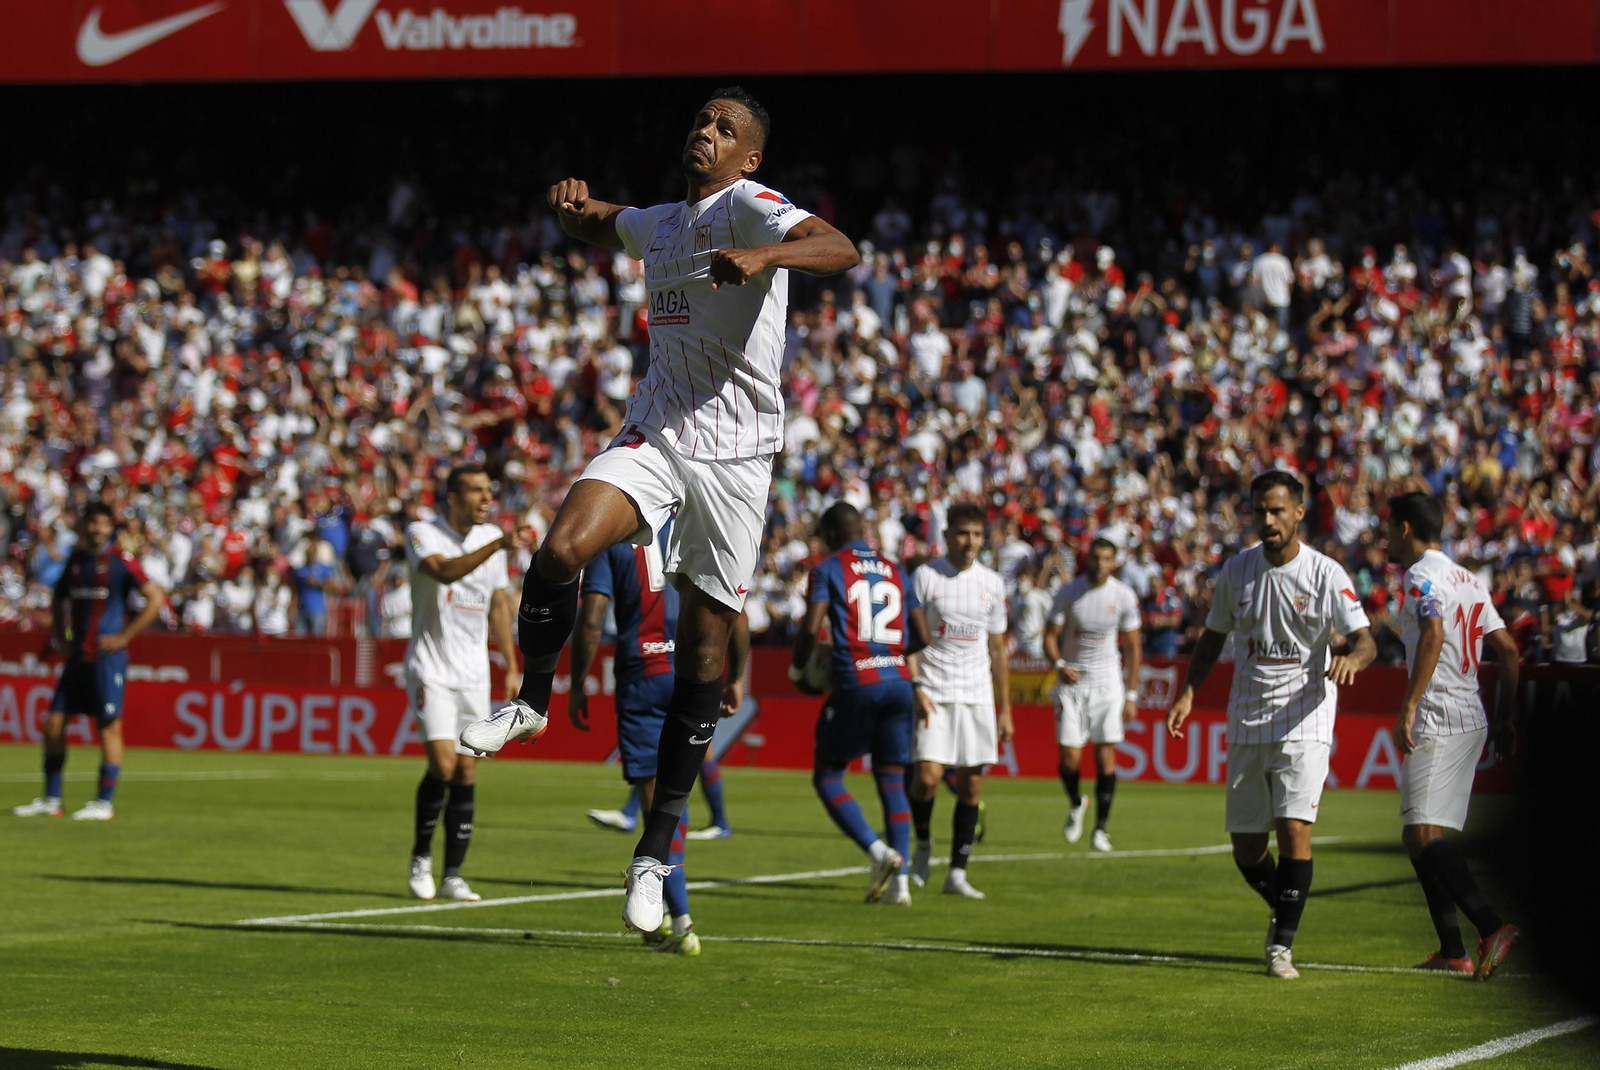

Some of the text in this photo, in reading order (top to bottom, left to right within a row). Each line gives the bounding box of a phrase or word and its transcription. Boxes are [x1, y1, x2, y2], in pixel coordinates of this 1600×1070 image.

[374, 7, 578, 50] Valvoline
[1107, 0, 1326, 56] NAGA
[847, 579, 903, 645] 12
[1257, 640, 1301, 657] NAGA
[171, 679, 377, 756] SÚPER
